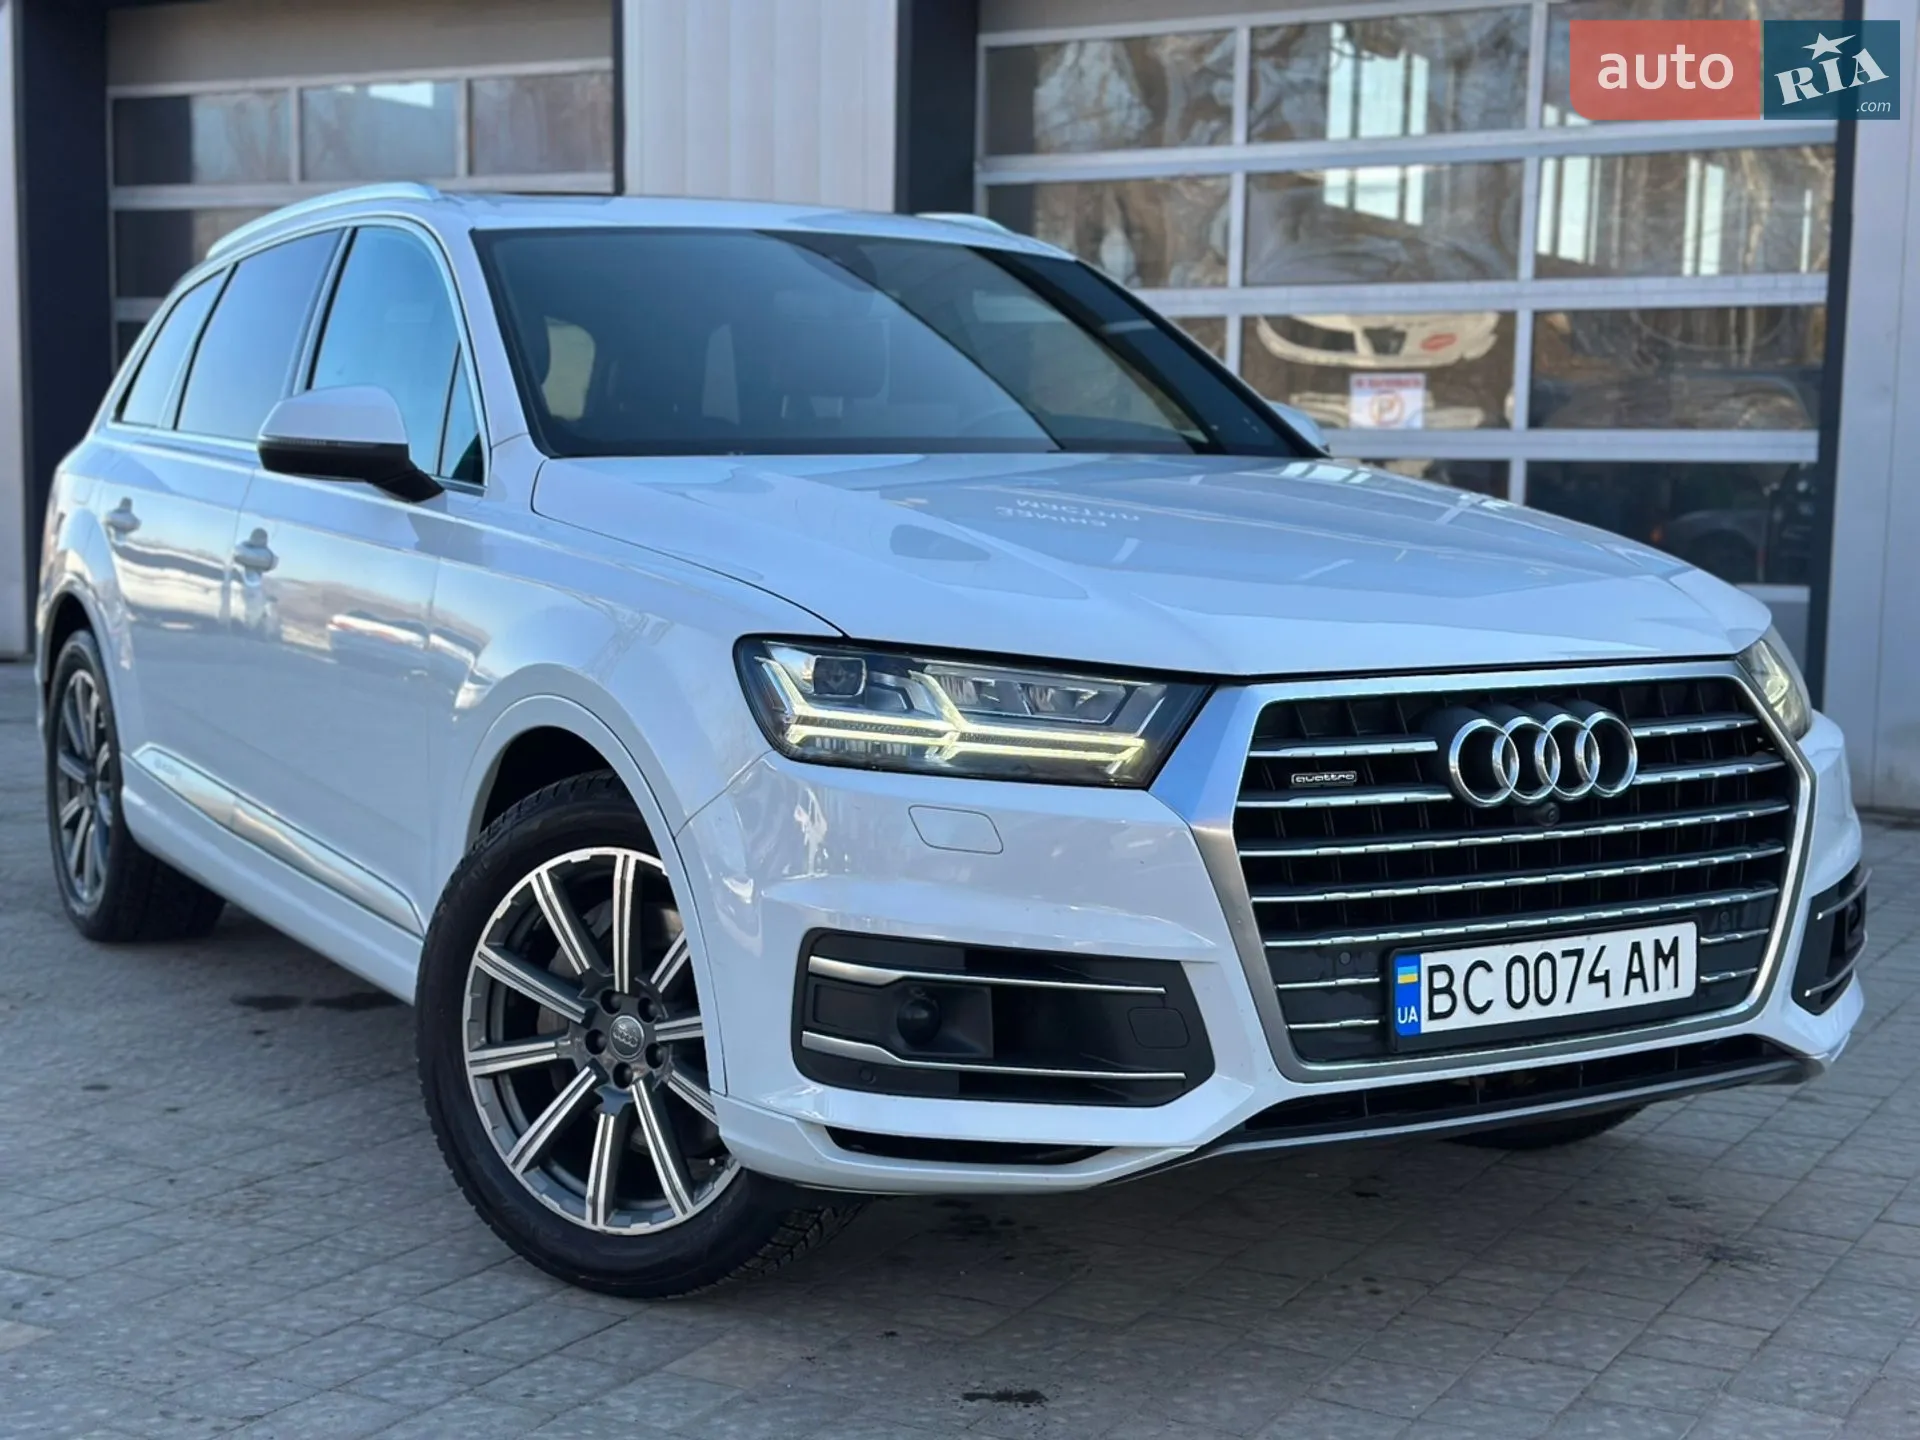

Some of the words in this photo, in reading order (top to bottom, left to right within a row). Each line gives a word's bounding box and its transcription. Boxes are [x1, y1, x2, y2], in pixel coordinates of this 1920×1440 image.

[1295, 773, 1355, 783] quattro
[1427, 959, 1494, 1021] BC
[1505, 945, 1611, 1010] 0074
[1623, 935, 1680, 996] AM
[1397, 1006, 1419, 1024] UA
